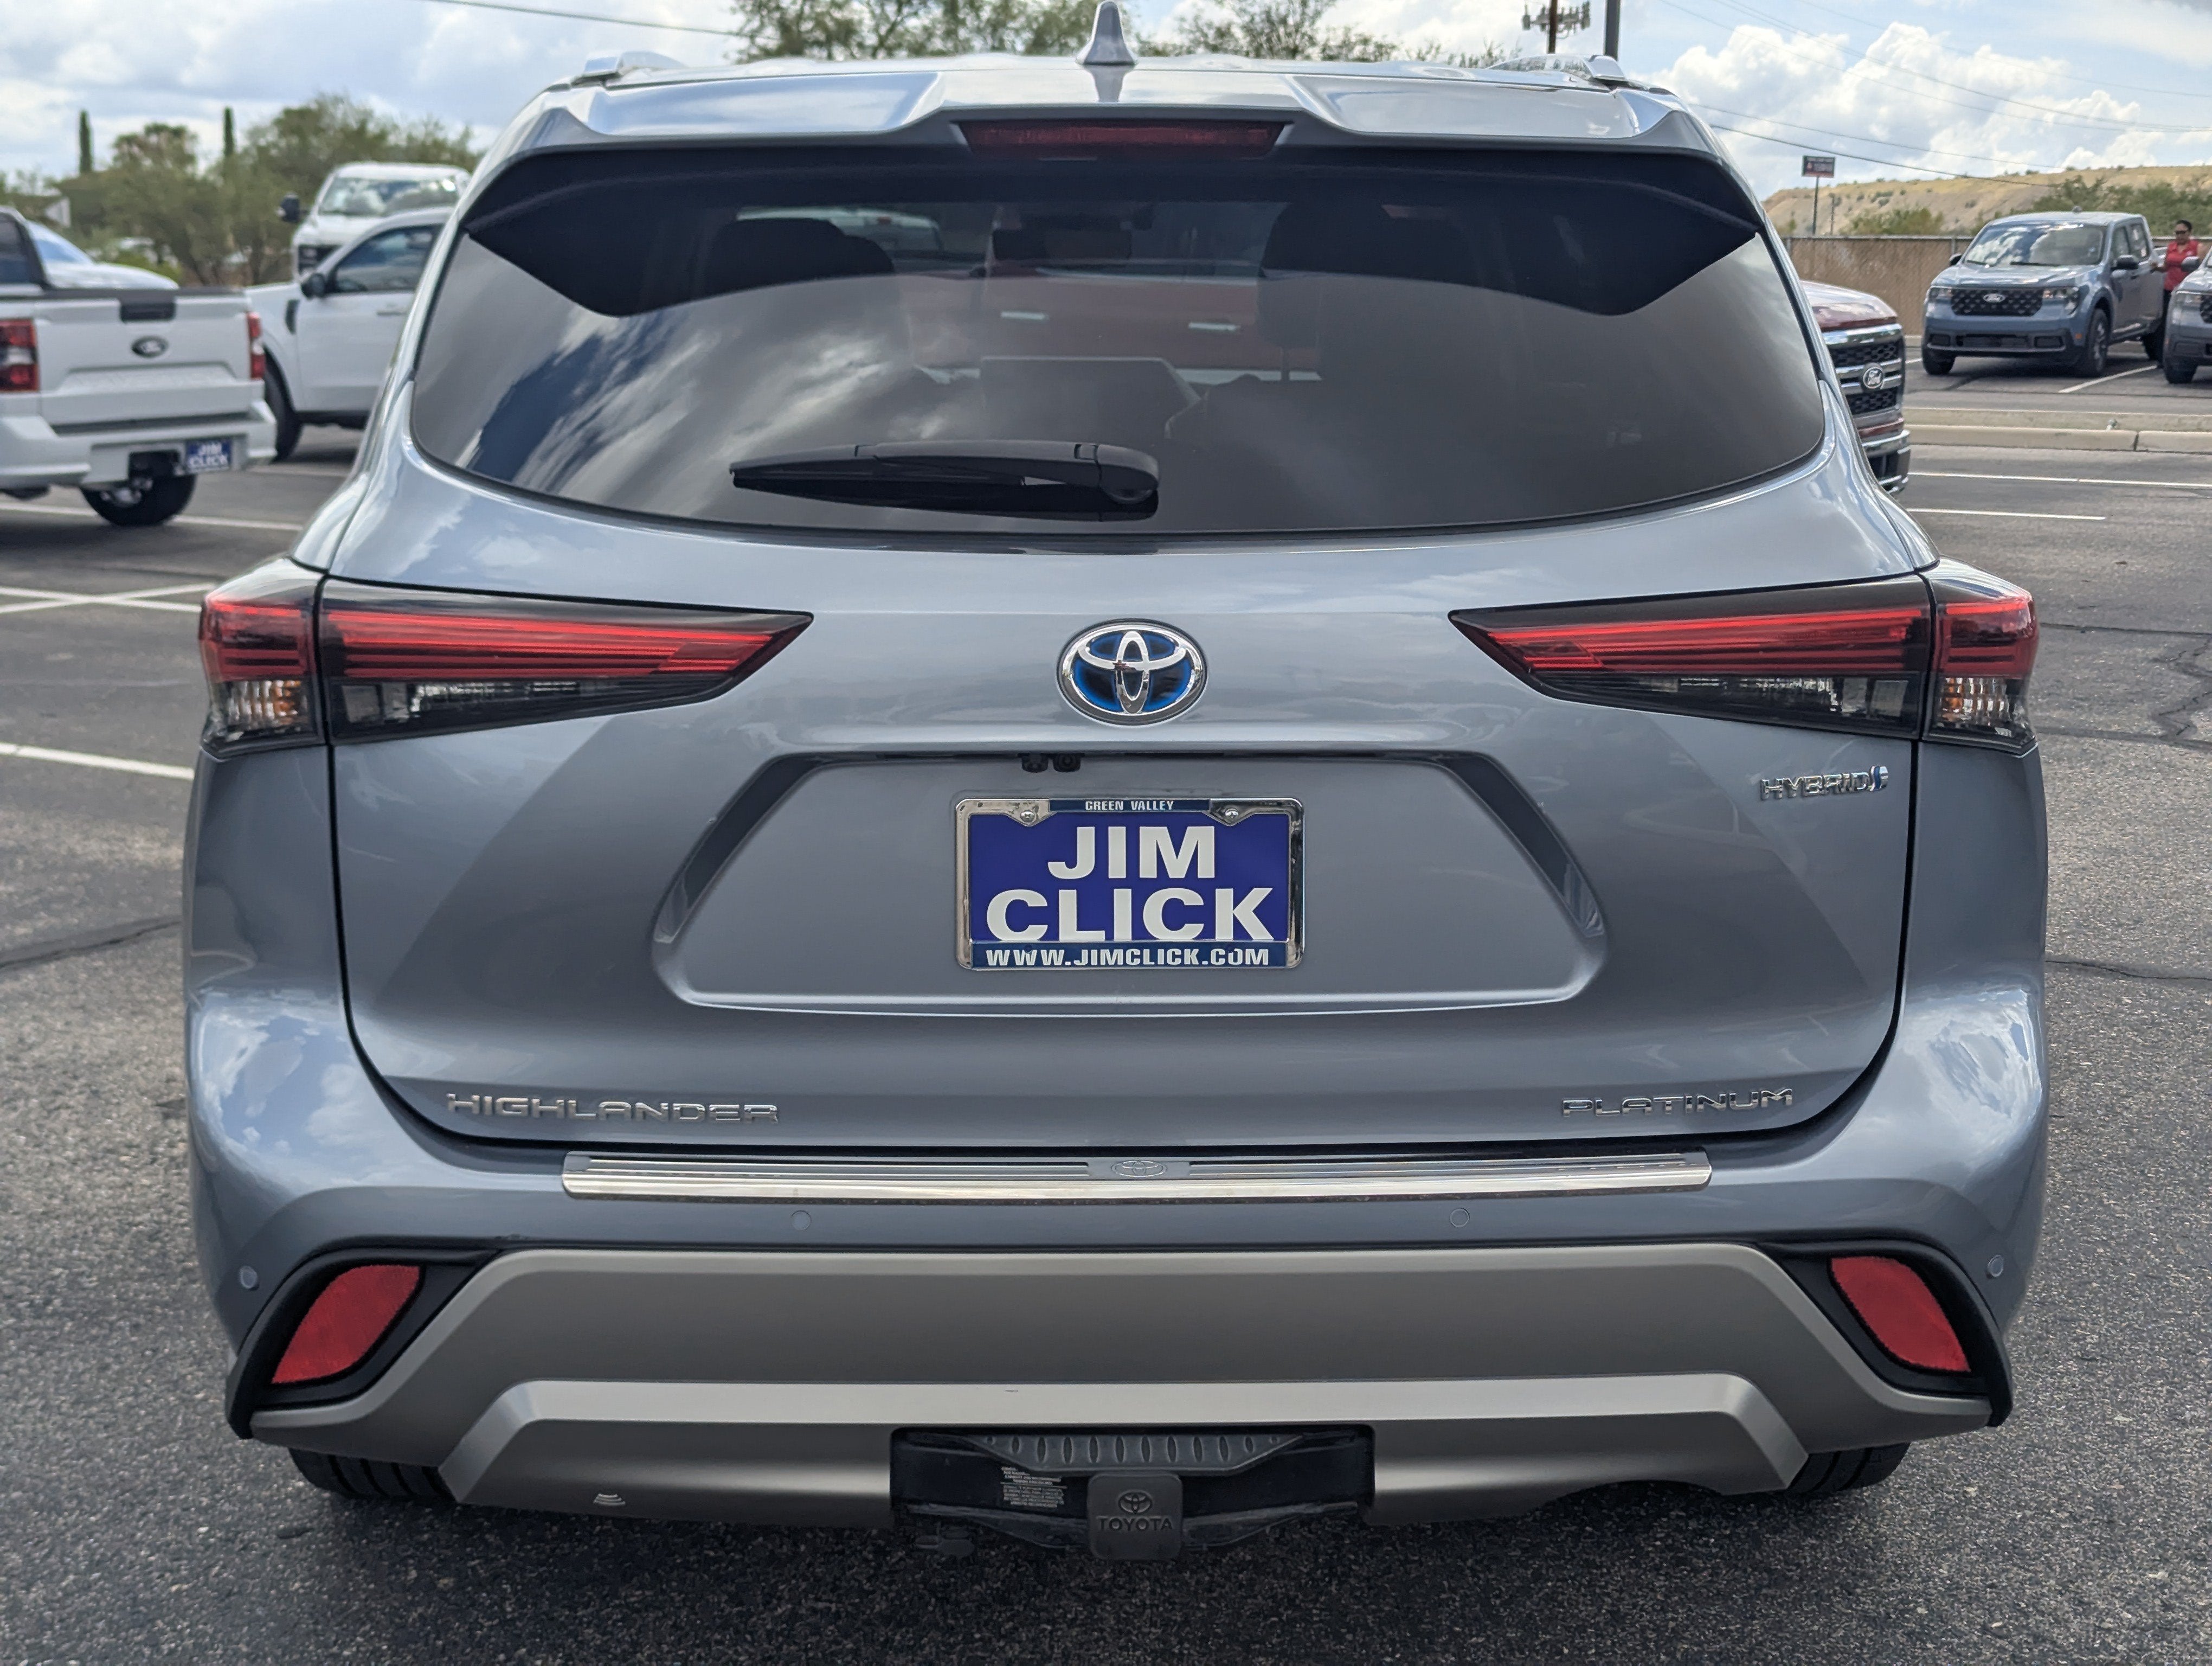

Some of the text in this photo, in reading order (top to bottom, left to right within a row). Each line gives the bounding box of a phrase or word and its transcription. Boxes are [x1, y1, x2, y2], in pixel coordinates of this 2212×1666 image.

[1761, 772, 1869, 800] HYBRID
[1085, 800, 1174, 811] GREEN VALLEY
[1047, 826, 1215, 879] JIM
[986, 888, 1274, 941] CLICK
[986, 948, 1269, 966] WWW.JIMCLICK.COM
[447, 1093, 779, 1124] HIGHLANDER
[1562, 1088, 1792, 1117] PLATINUM
[1096, 1516, 1173, 1531] TOYOTA
